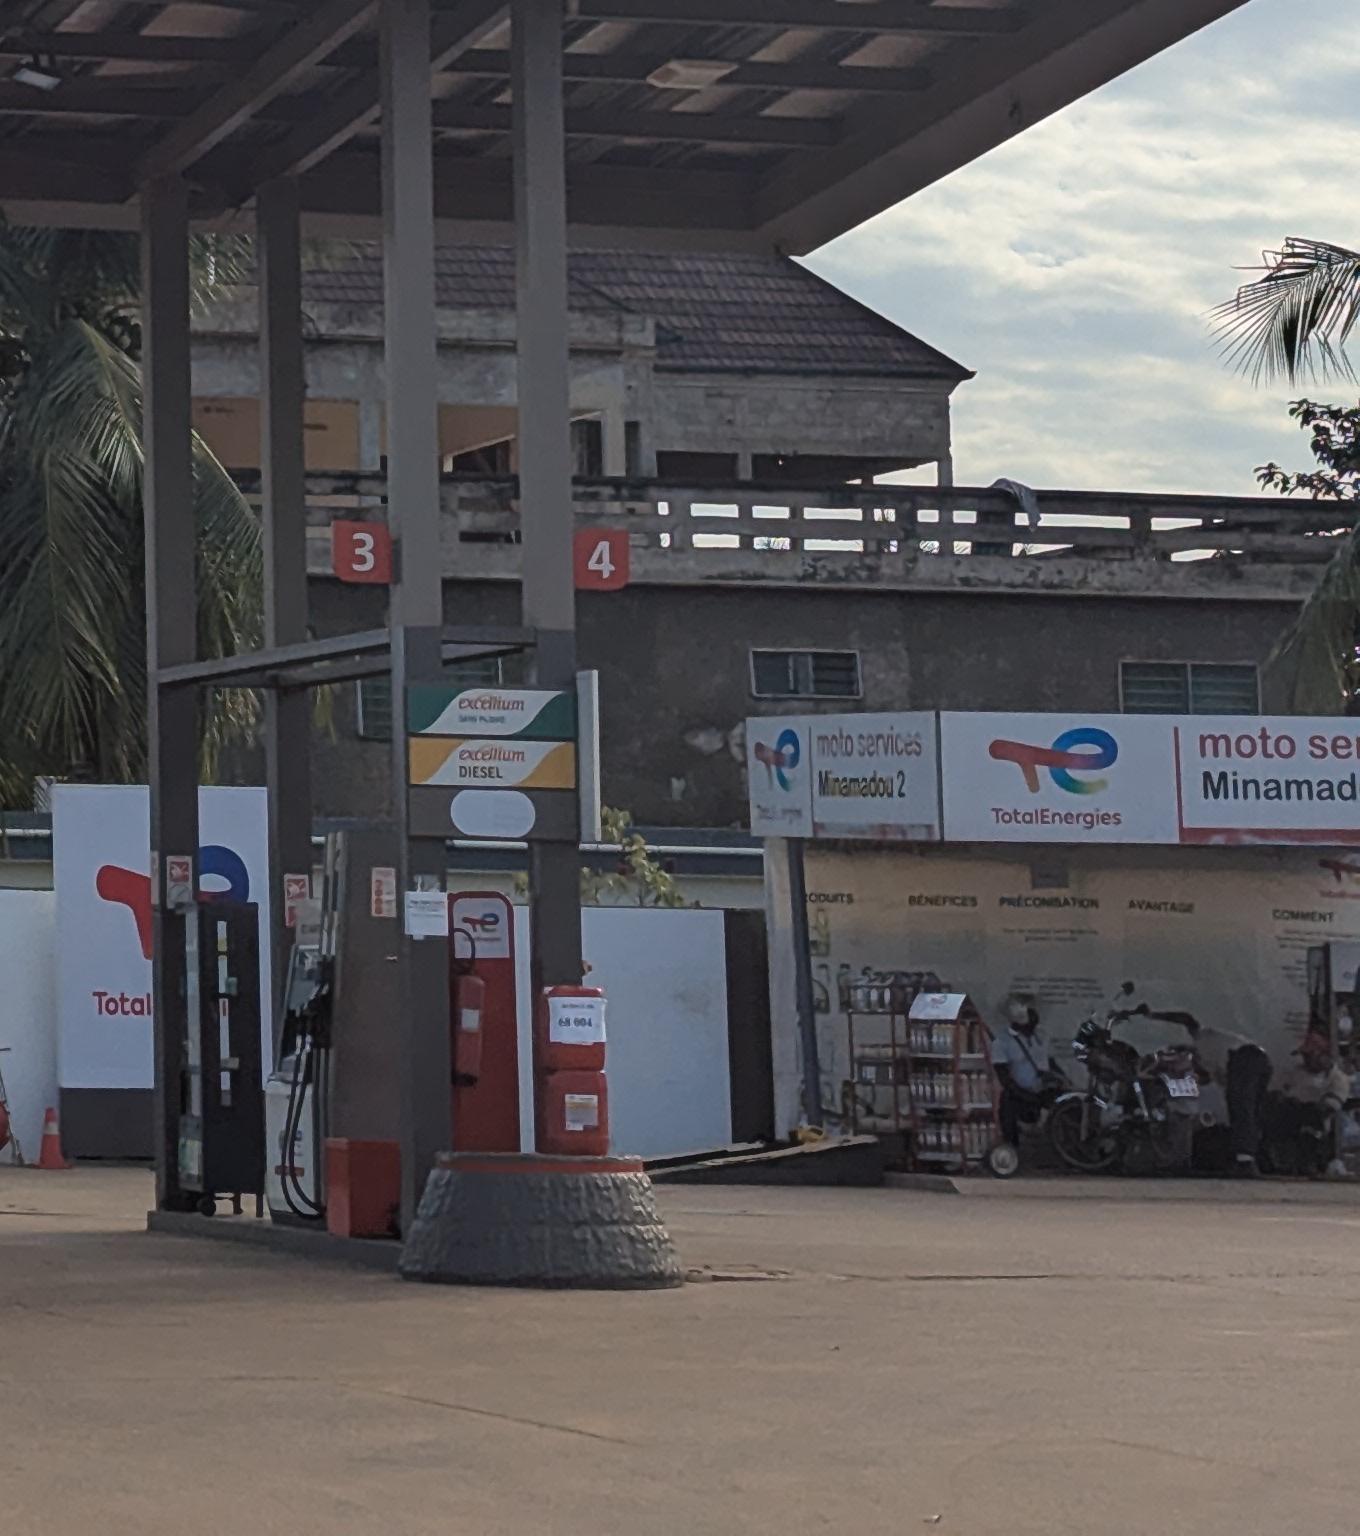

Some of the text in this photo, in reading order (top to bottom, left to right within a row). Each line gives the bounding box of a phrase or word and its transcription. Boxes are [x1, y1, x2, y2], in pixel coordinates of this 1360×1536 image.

[352, 532, 377, 572] 3
[587, 540, 616, 579] 4
[458, 695, 525, 711] excellium
[458, 746, 525, 762] excellium
[816, 726, 854, 757] moto
[1199, 727, 1297, 760] moto
[458, 765, 504, 779] DIESEL
[818, 770, 906, 798] Minamadou 2
[1202, 771, 1360, 802] Minamad
[990, 807, 1122, 830] TotalEnergies
